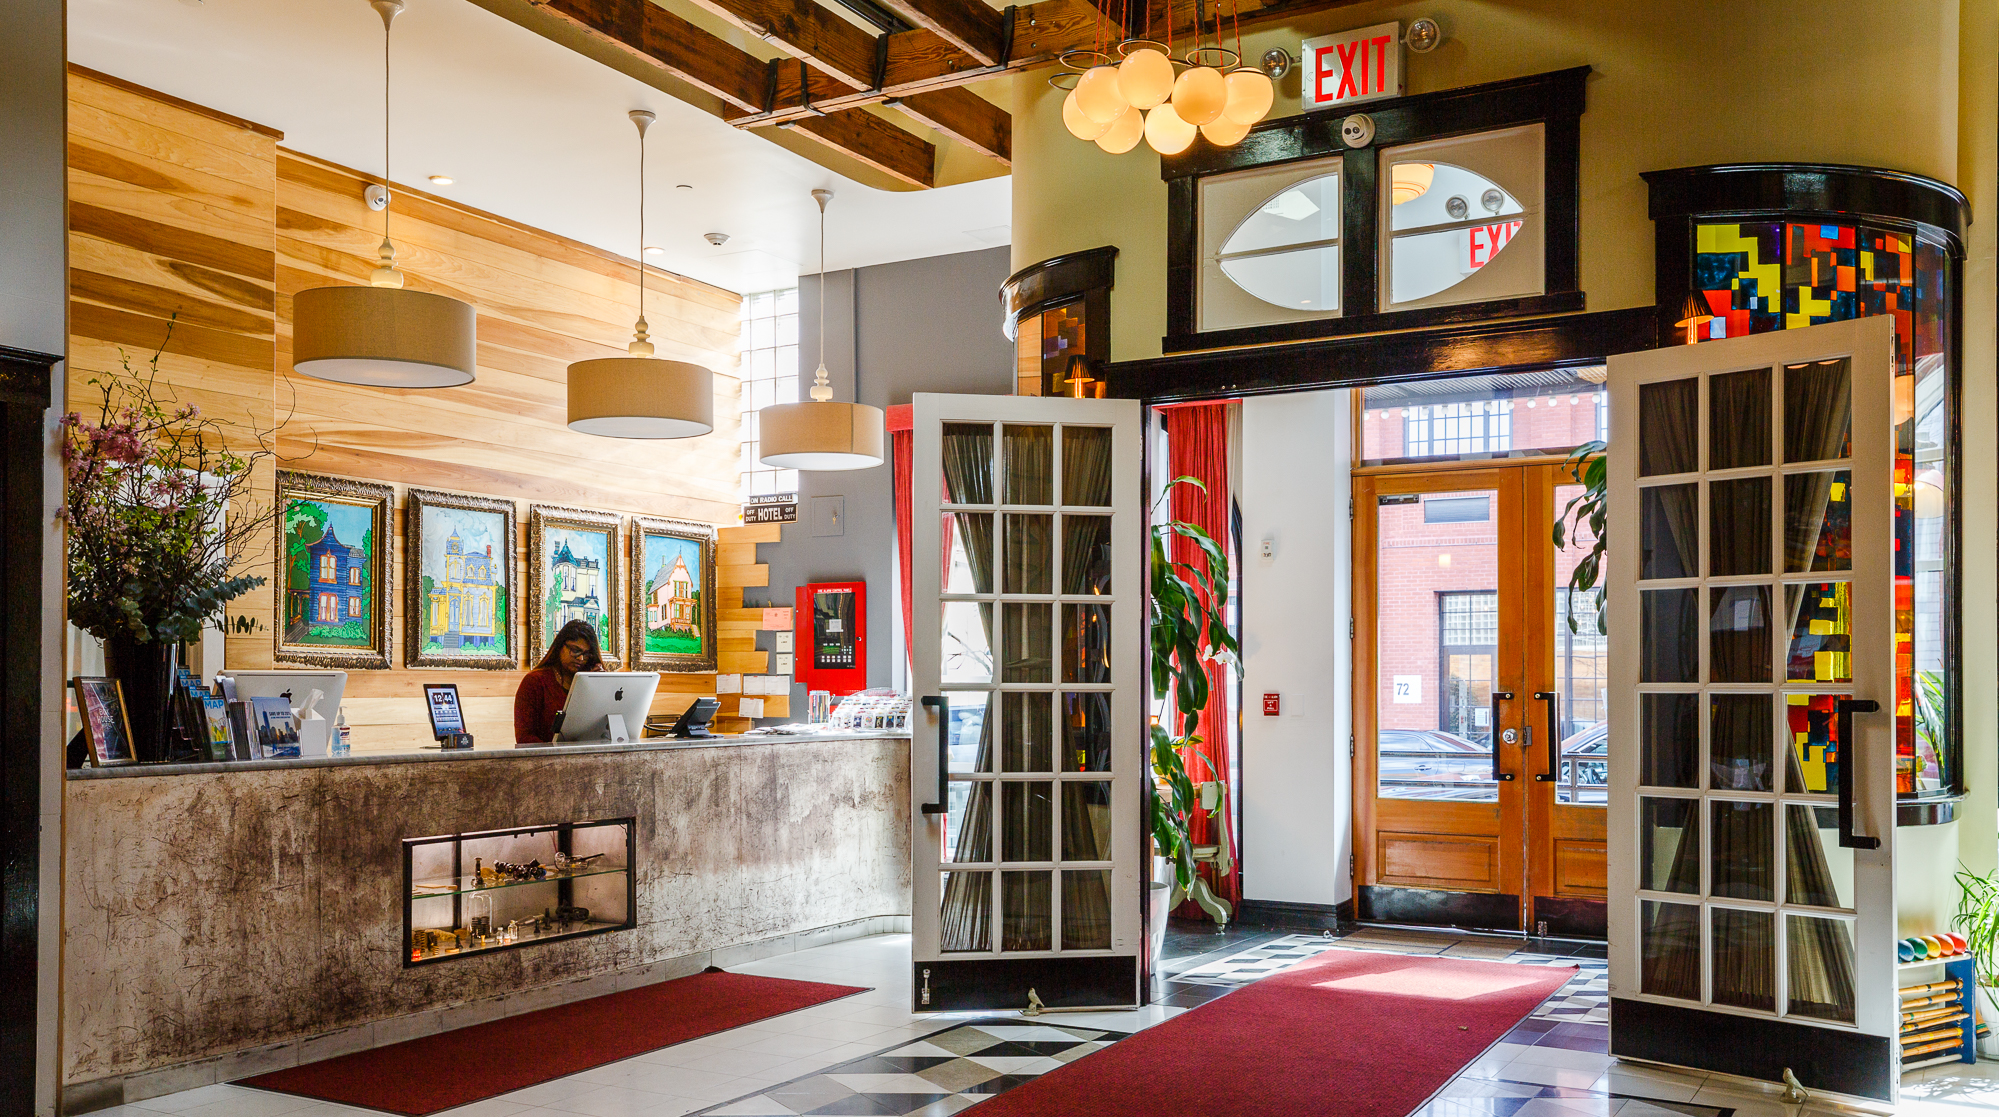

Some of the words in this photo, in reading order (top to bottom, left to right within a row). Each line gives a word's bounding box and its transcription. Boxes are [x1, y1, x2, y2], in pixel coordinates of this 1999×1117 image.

[1315, 35, 1391, 103] EXIT
[758, 507, 782, 521] HOTEL
[181, 679, 202, 687] MAP
[190, 690, 211, 698] MAP
[1396, 683, 1410, 695] 72
[434, 694, 443, 702] 12
[204, 699, 224, 710] MAP
[97, 715, 115, 724] HOUSE
